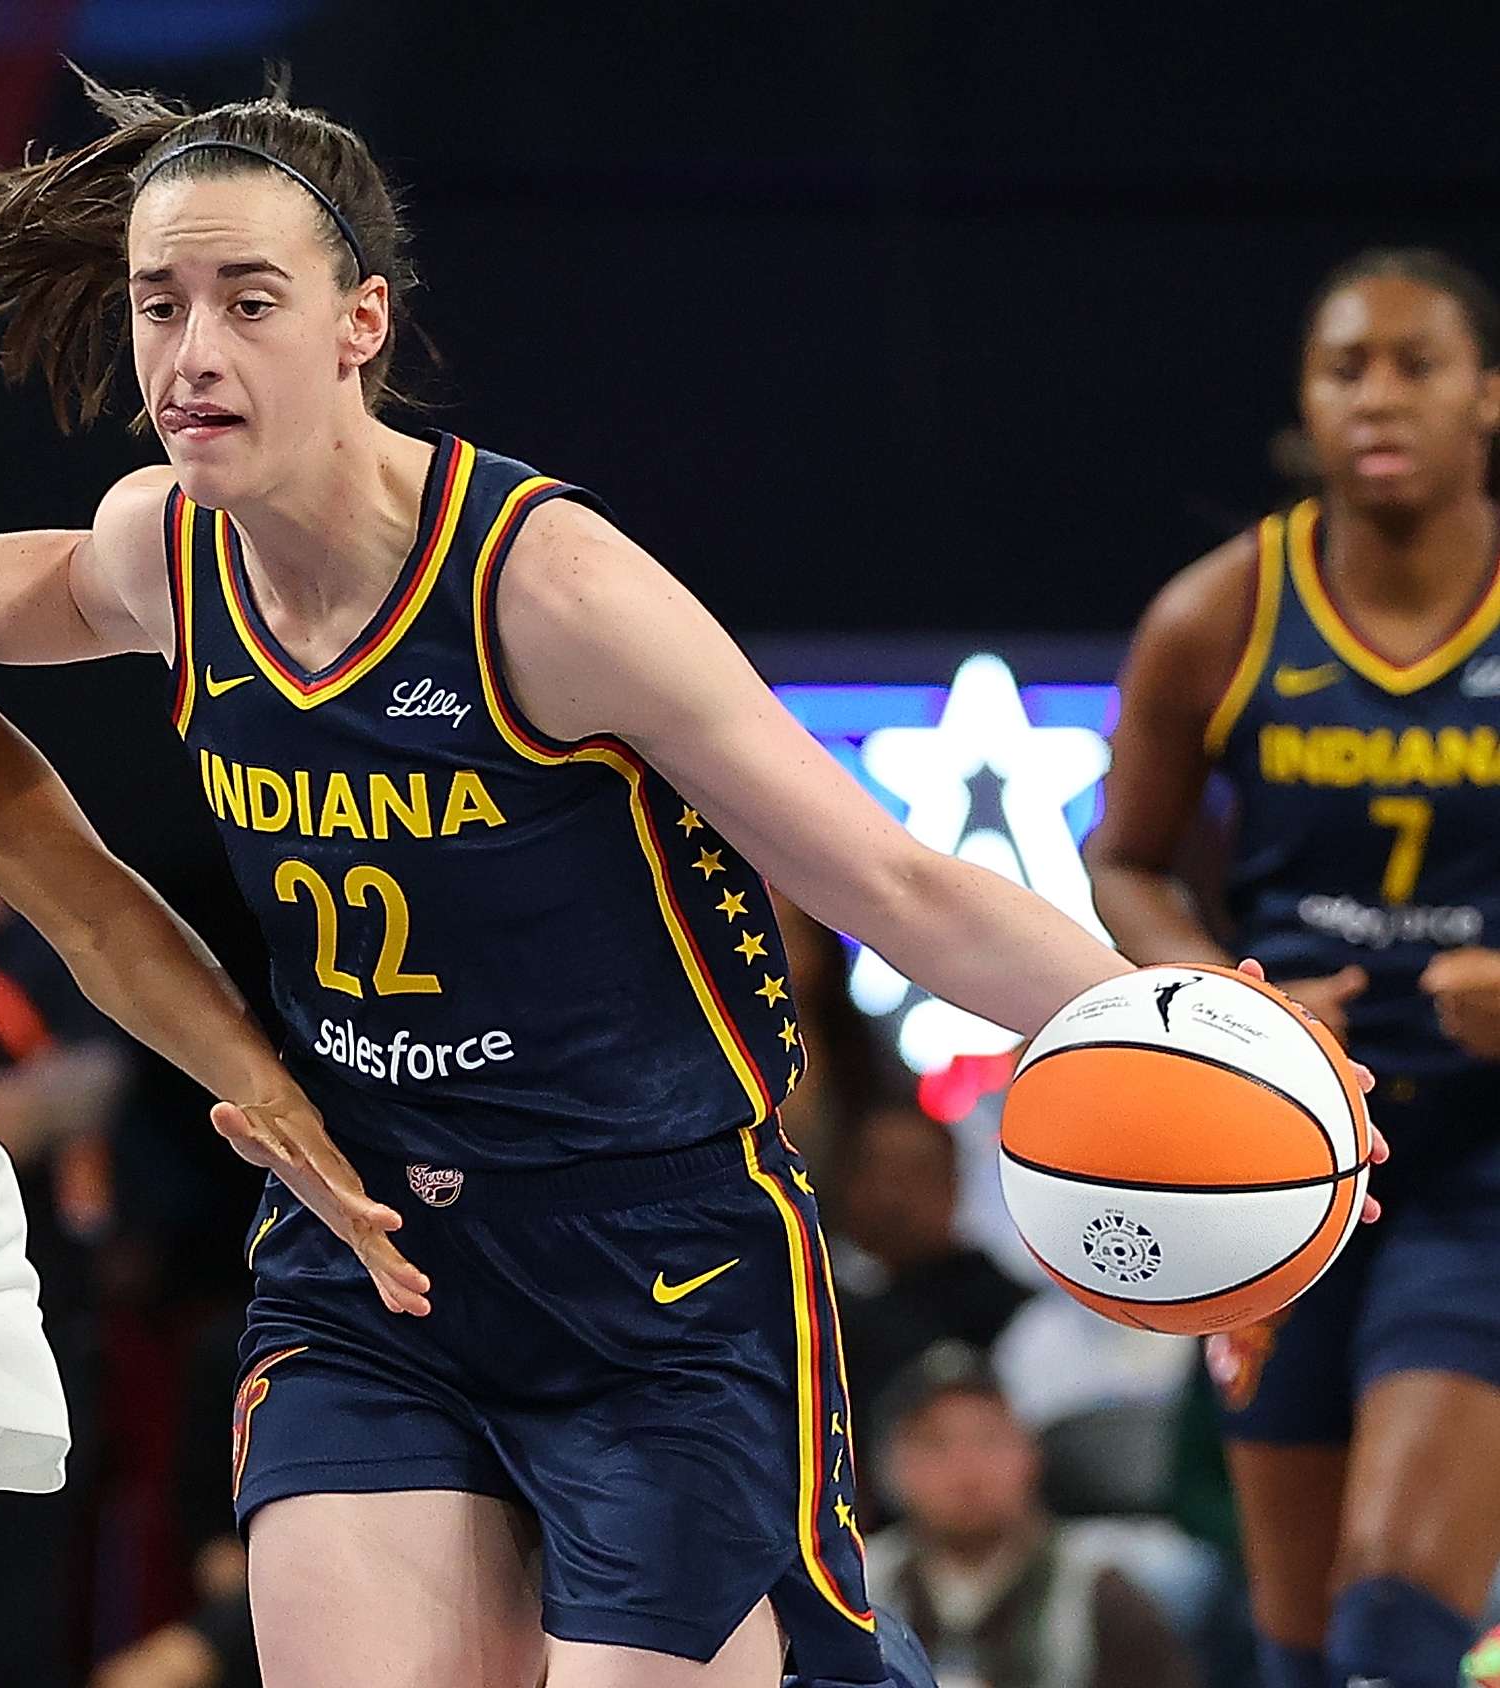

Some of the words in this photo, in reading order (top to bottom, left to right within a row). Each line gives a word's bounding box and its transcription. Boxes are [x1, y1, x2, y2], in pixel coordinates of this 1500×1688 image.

[386, 678, 472, 729] Lilly
[200, 749, 507, 840] INDIANA
[1257, 723, 1500, 788] INDIAN
[1367, 795, 1434, 906] 7
[274, 859, 443, 1000] 22
[314, 1018, 515, 1086] salesforce
